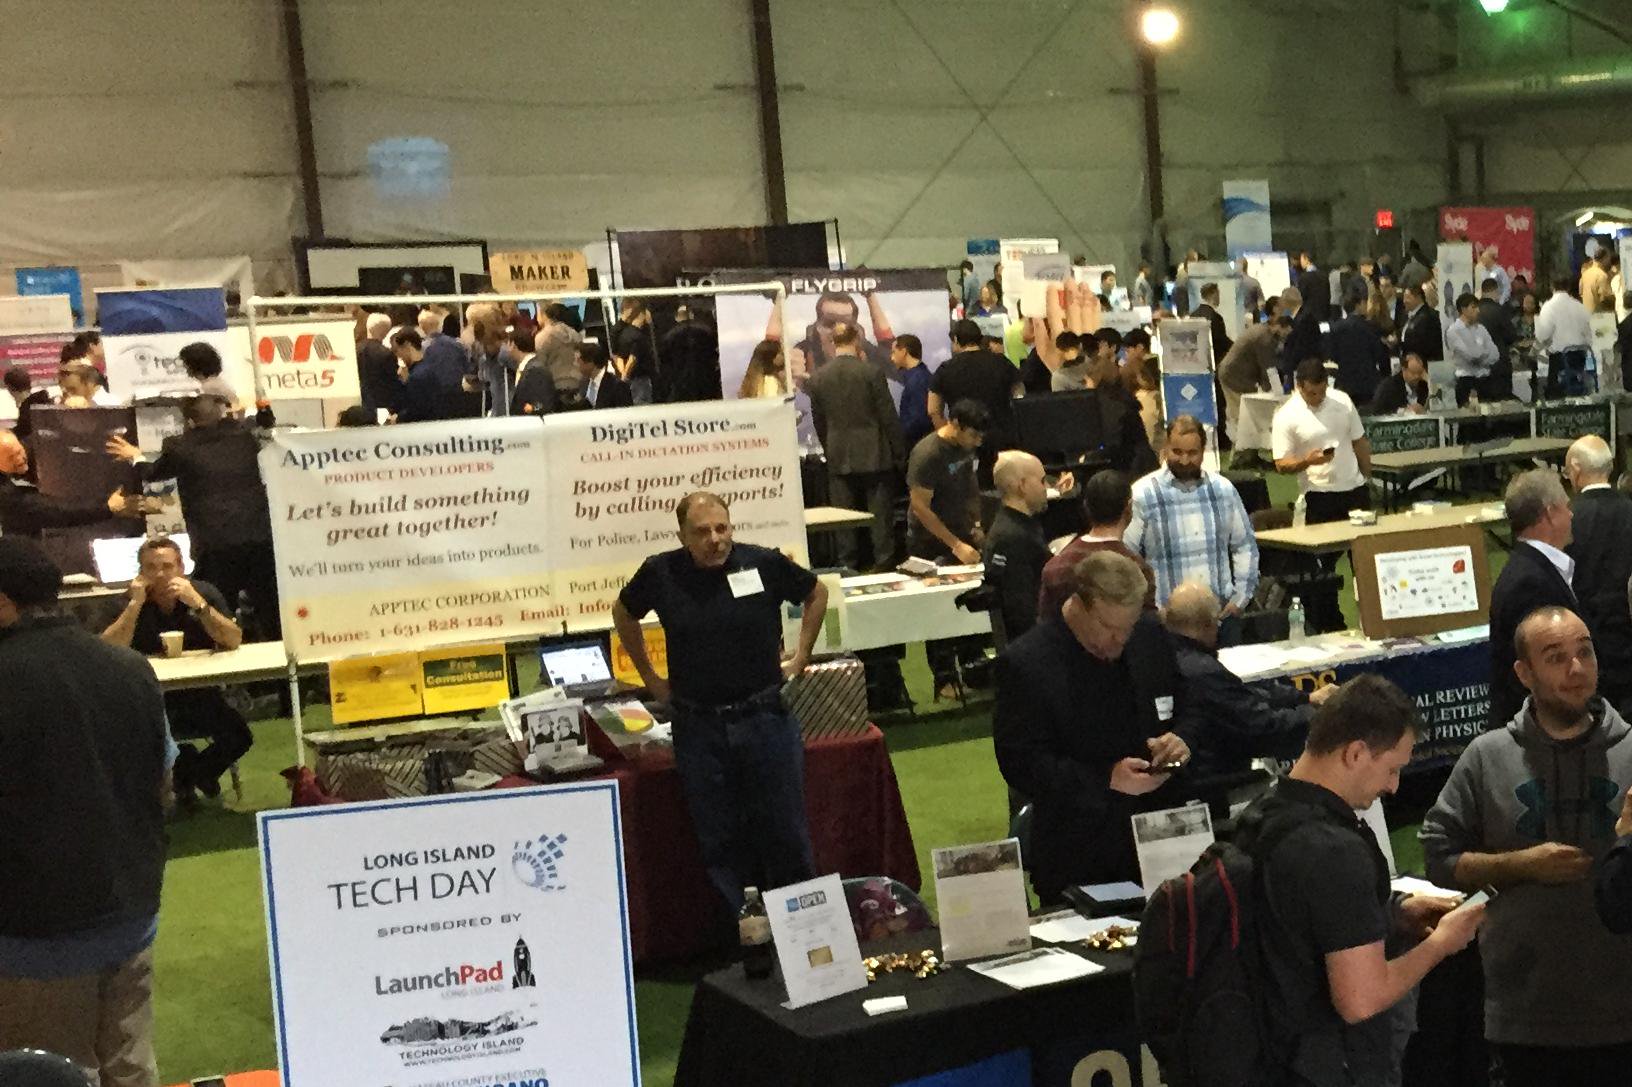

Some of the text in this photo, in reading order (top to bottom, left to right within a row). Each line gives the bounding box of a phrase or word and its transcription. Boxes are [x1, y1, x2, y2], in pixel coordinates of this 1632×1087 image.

[509, 264, 573, 282] MAKER
[791, 277, 877, 293] FLYGRIP
[590, 418, 668, 444] DigiTel
[281, 444, 369, 472] Apptec
[638, 443, 709, 459] DICTATION
[712, 437, 770, 451] SYSTEMS
[324, 461, 495, 486] PRODUCT DEVELOPERS
[573, 464, 784, 496] Boost your efficiency
[286, 486, 531, 522] Let's build something
[575, 501, 600, 522] by
[606, 494, 677, 516] calling
[326, 510, 498, 546] great together!
[570, 536, 593, 550] For
[598, 531, 640, 548] Police,
[288, 561, 328, 579] We'll
[332, 562, 365, 576] turn
[368, 557, 401, 573] your
[406, 553, 444, 568] ideas
[448, 549, 476, 563] into
[369, 600, 432, 617] APPTEC
[435, 585, 551, 610] CORPORATION
[569, 580, 597, 594] Port
[308, 628, 369, 646] Phone:
[520, 605, 570, 622] Email:
[426, 669, 503, 686] Consultation
[1436, 683, 1491, 704] REVIEW
[1433, 701, 1491, 723] LETTERS
[1435, 719, 1489, 740] PHYSIC
[363, 843, 496, 872] LONG ISLAND
[328, 867, 497, 910] TECH DAY
[377, 912, 523, 939] SPONSORED BY
[375, 960, 505, 997] LaunchPad
[399, 1036, 525, 1061] TECHNOLOGY ISLAND
[454, 1074, 494, 1086] COUNTY
[494, 1067, 547, 1083] EXECUTIVE
